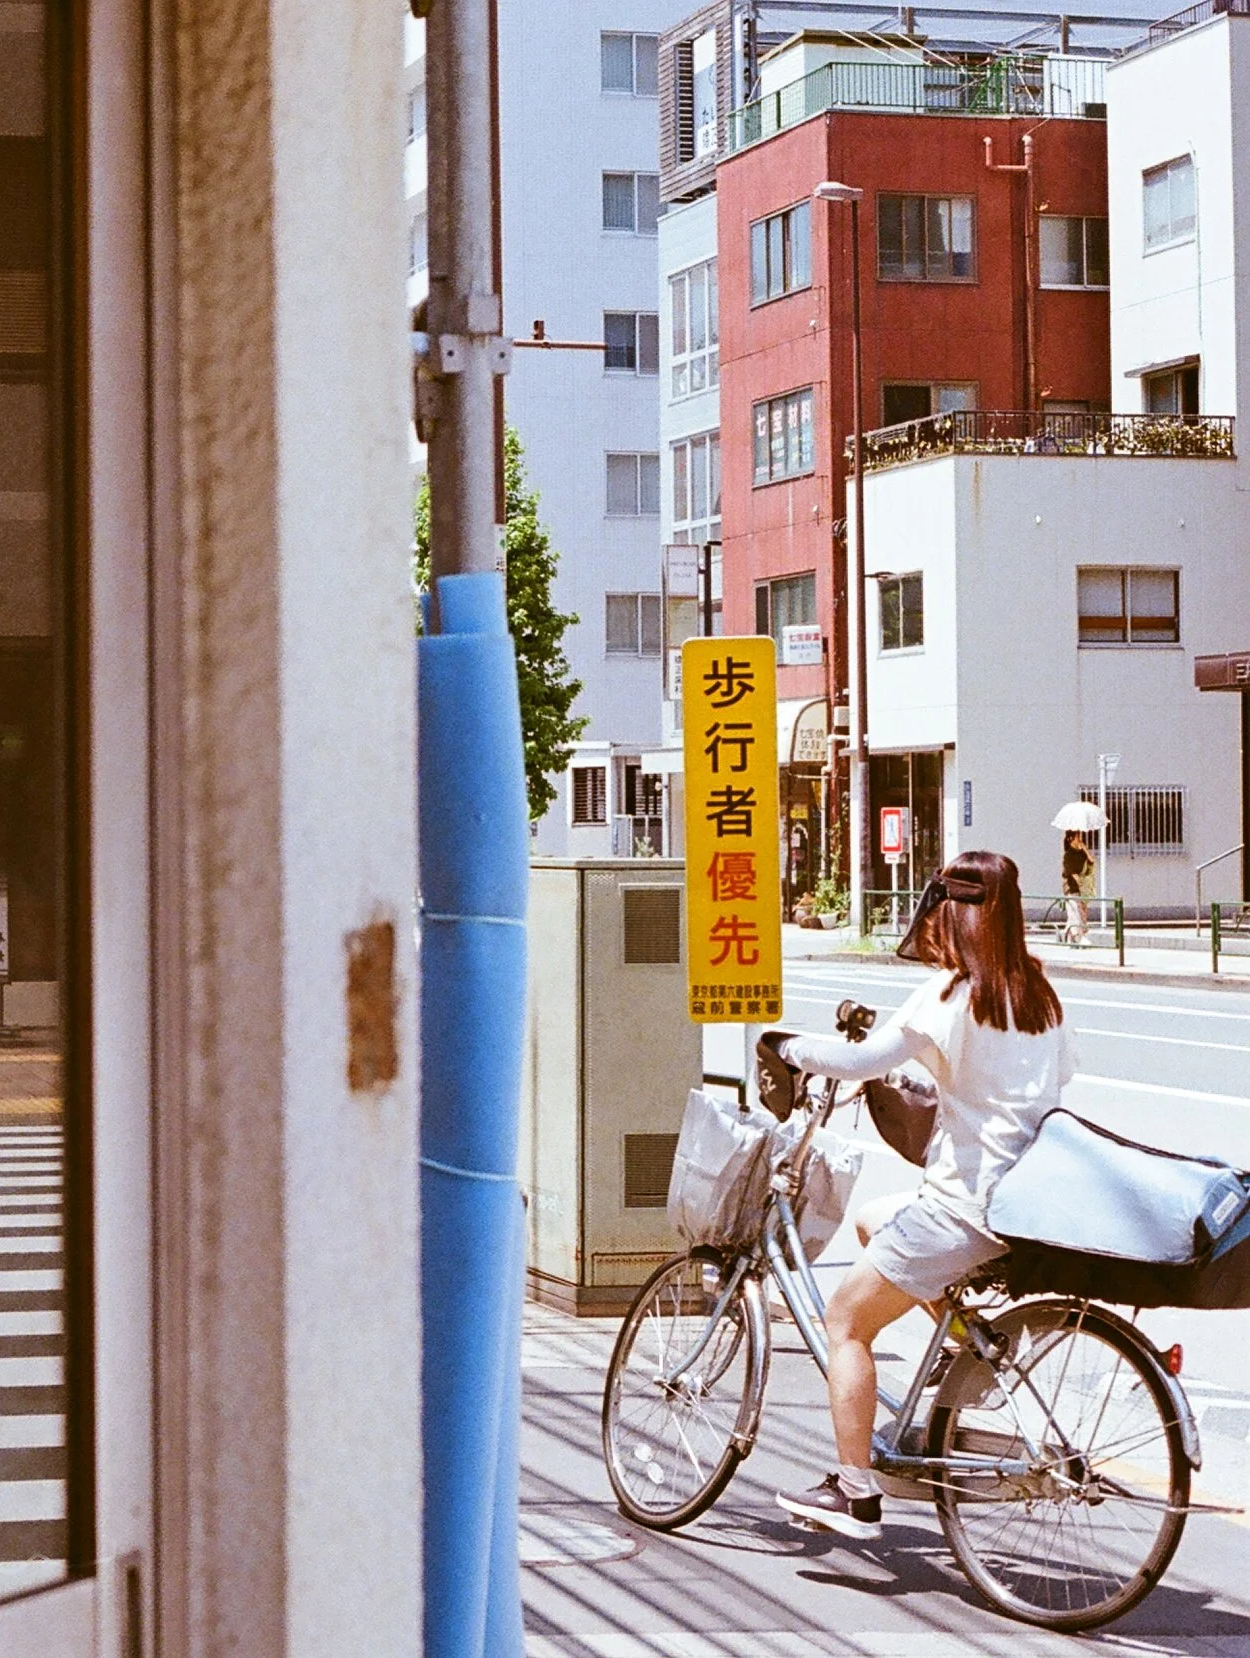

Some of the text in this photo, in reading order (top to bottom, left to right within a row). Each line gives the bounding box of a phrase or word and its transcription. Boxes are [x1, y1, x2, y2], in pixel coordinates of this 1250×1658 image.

[703, 656, 760, 967] 歩行者優先
[691, 1001, 780, 1015] 蔵前警察署
